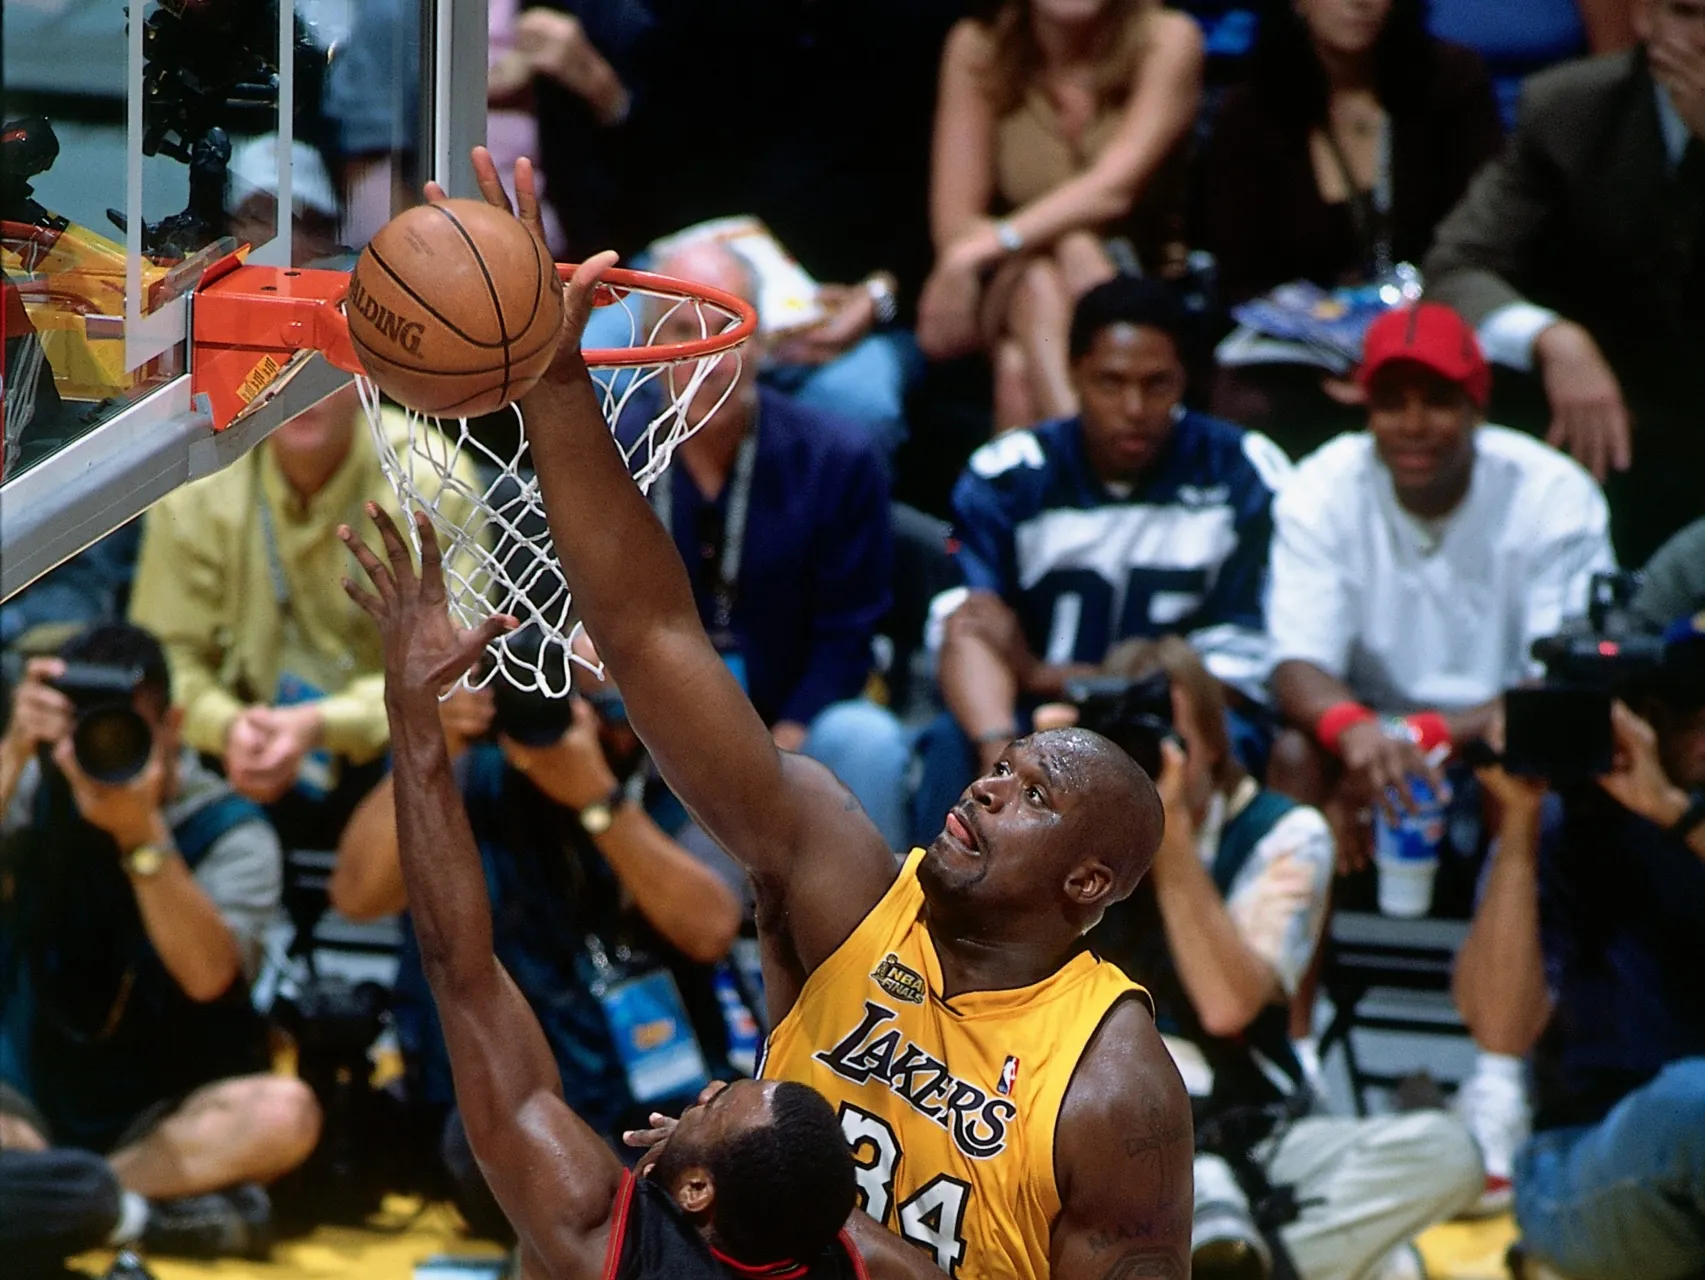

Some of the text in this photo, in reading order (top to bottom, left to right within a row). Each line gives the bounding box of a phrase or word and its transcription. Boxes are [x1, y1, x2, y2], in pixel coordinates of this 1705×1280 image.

[350, 274, 425, 356] ALDING
[881, 977, 925, 1004] FINALS
[888, 966, 925, 991] NBA
[811, 1000, 1017, 1161] LAKERS
